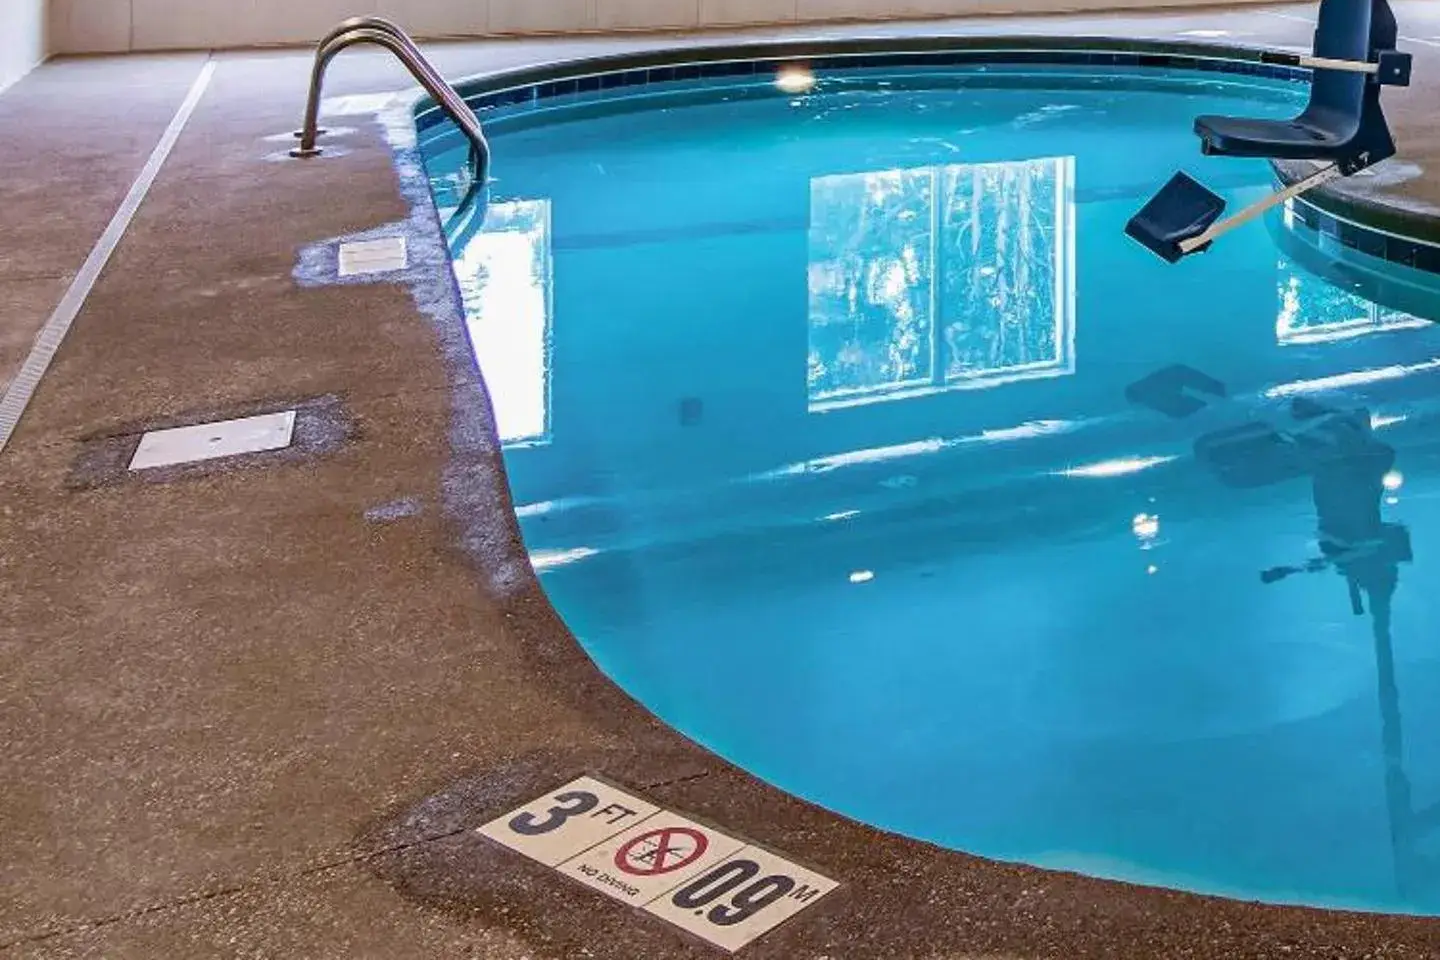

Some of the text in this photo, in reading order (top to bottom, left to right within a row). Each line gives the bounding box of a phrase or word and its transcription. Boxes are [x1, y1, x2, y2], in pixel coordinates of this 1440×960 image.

[508, 790, 637, 836] 3 FT
[577, 864, 640, 896] NO DIVING
[671, 858, 817, 927] 0.9 M
